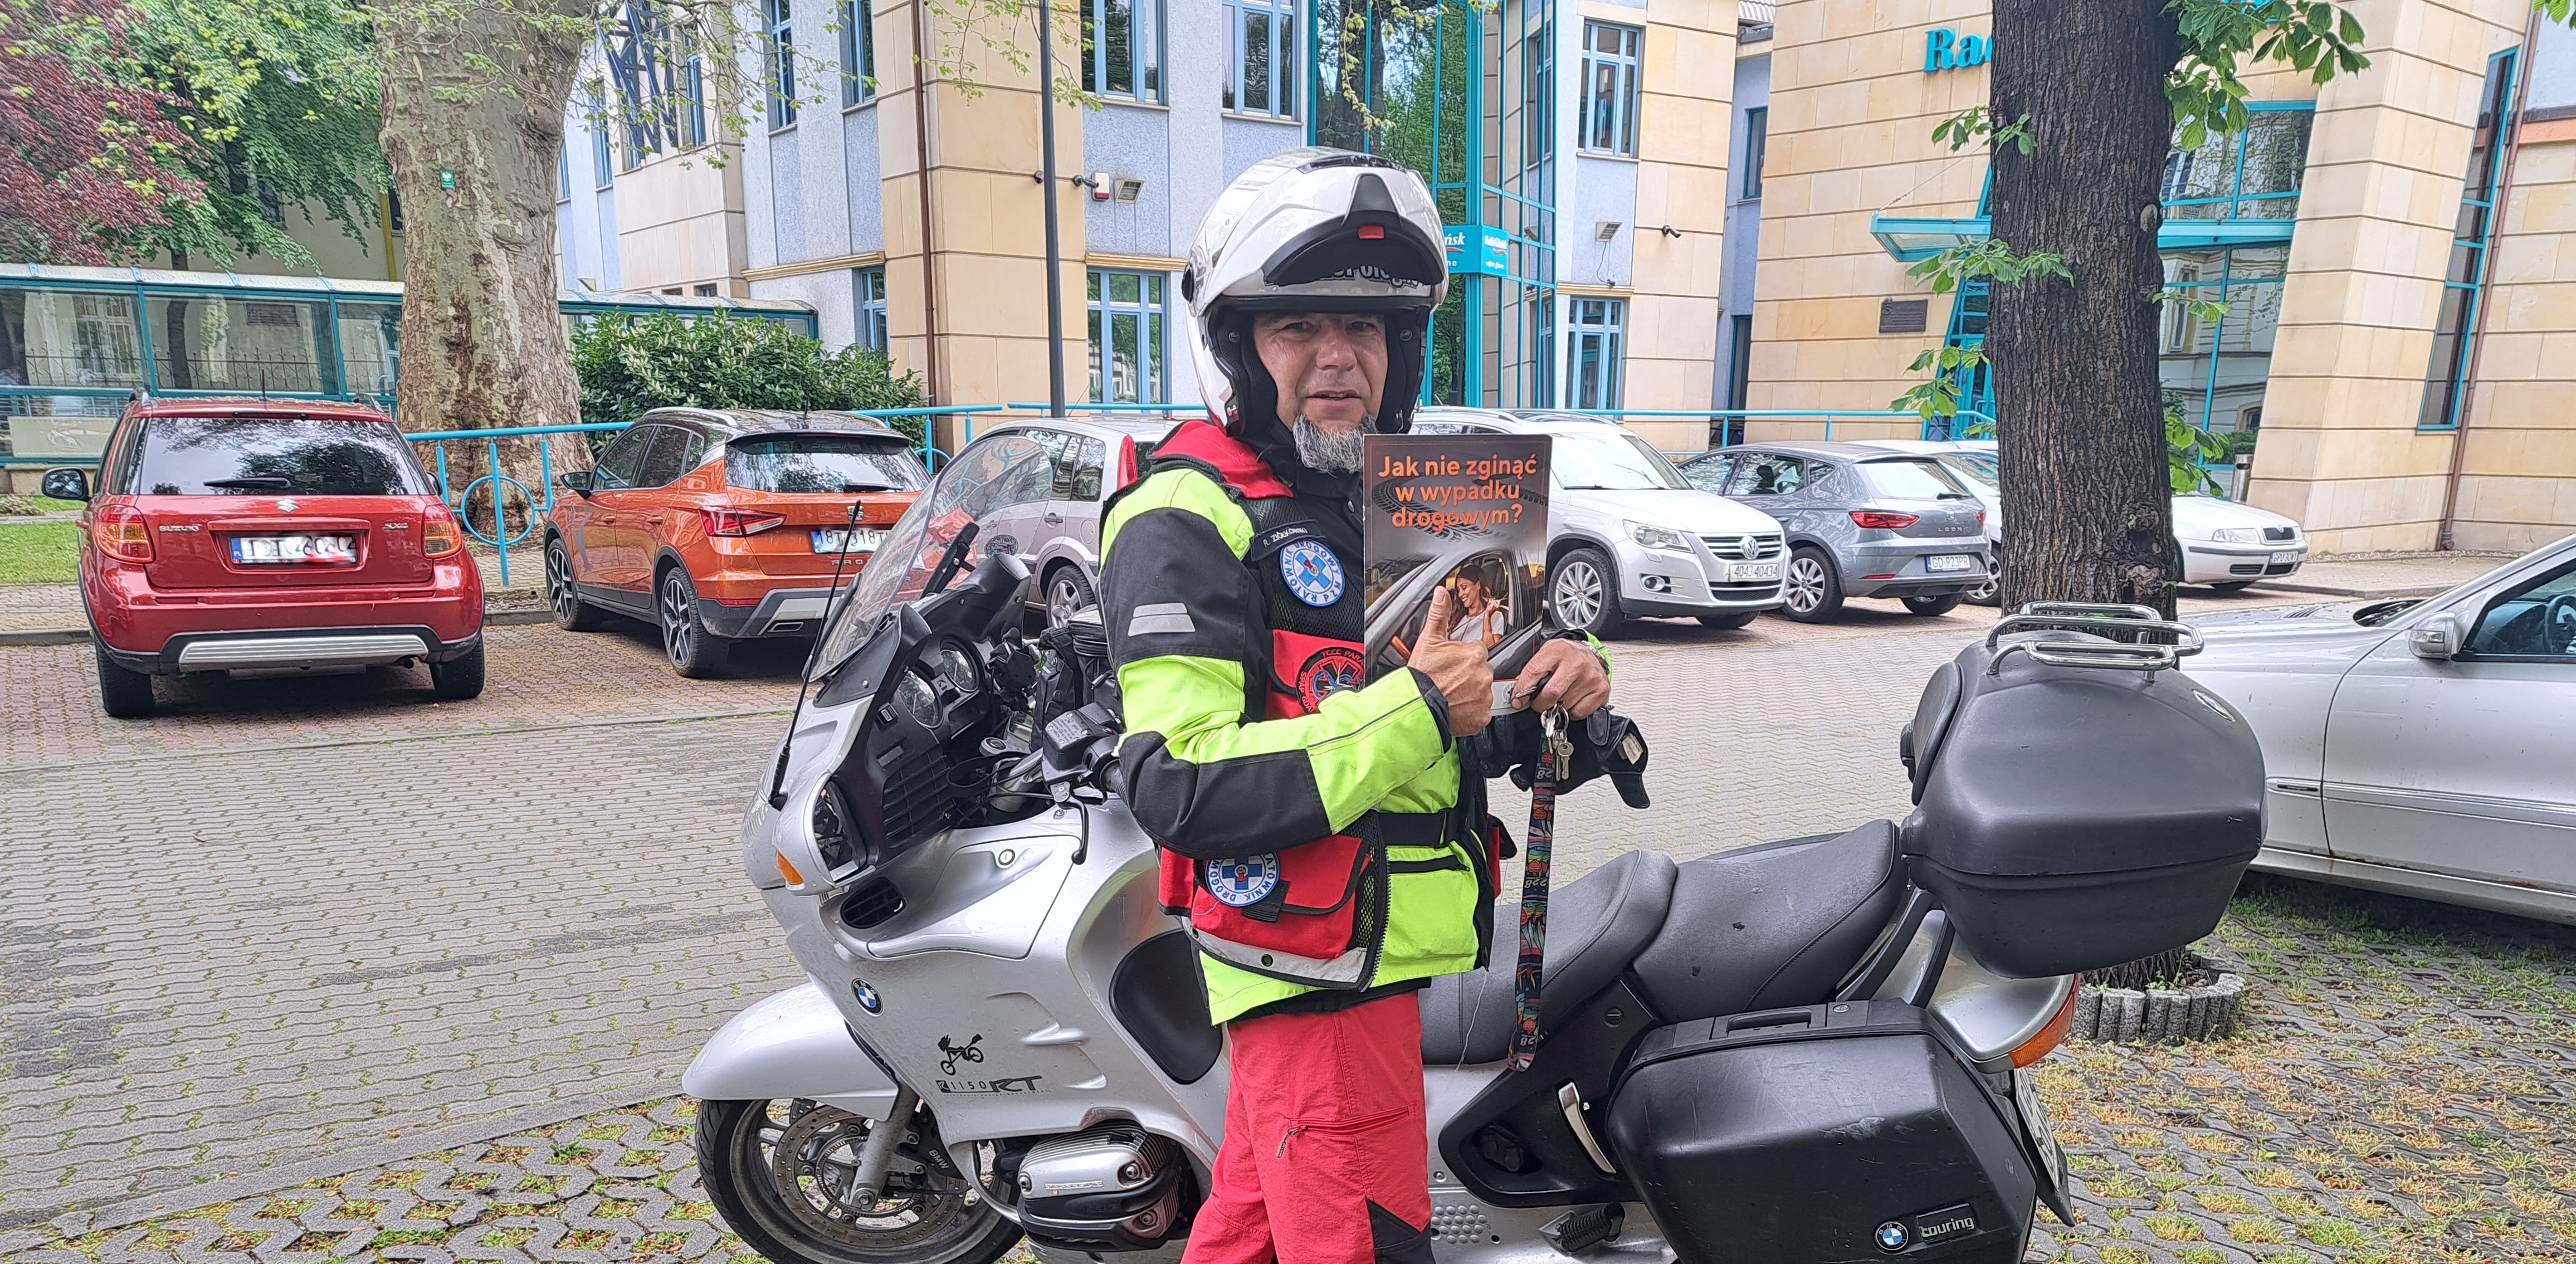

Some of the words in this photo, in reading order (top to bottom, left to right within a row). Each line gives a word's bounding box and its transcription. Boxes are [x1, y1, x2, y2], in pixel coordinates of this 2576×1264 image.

[1378, 455, 1419, 477] Jak
[1426, 455, 1460, 476] nie
[1466, 454, 1537, 480] zginąć
[1395, 486, 1414, 501] w
[1421, 480, 1520, 507] wypadku
[1392, 503, 1523, 531] drogowym?
[1294, 541, 1340, 575] DROGOWY
[1932, 558, 1944, 568] GD
[1946, 557, 1969, 568] 923PR
[1284, 548, 1318, 603] RATOWNIK
[1321, 649, 1341, 658] TCCC
[1299, 671, 1307, 692] SPAP
[1243, 854, 1276, 901] ATOWNIK
[929, 1149, 950, 1169] BMW
[1920, 1216, 1975, 1238] touring
